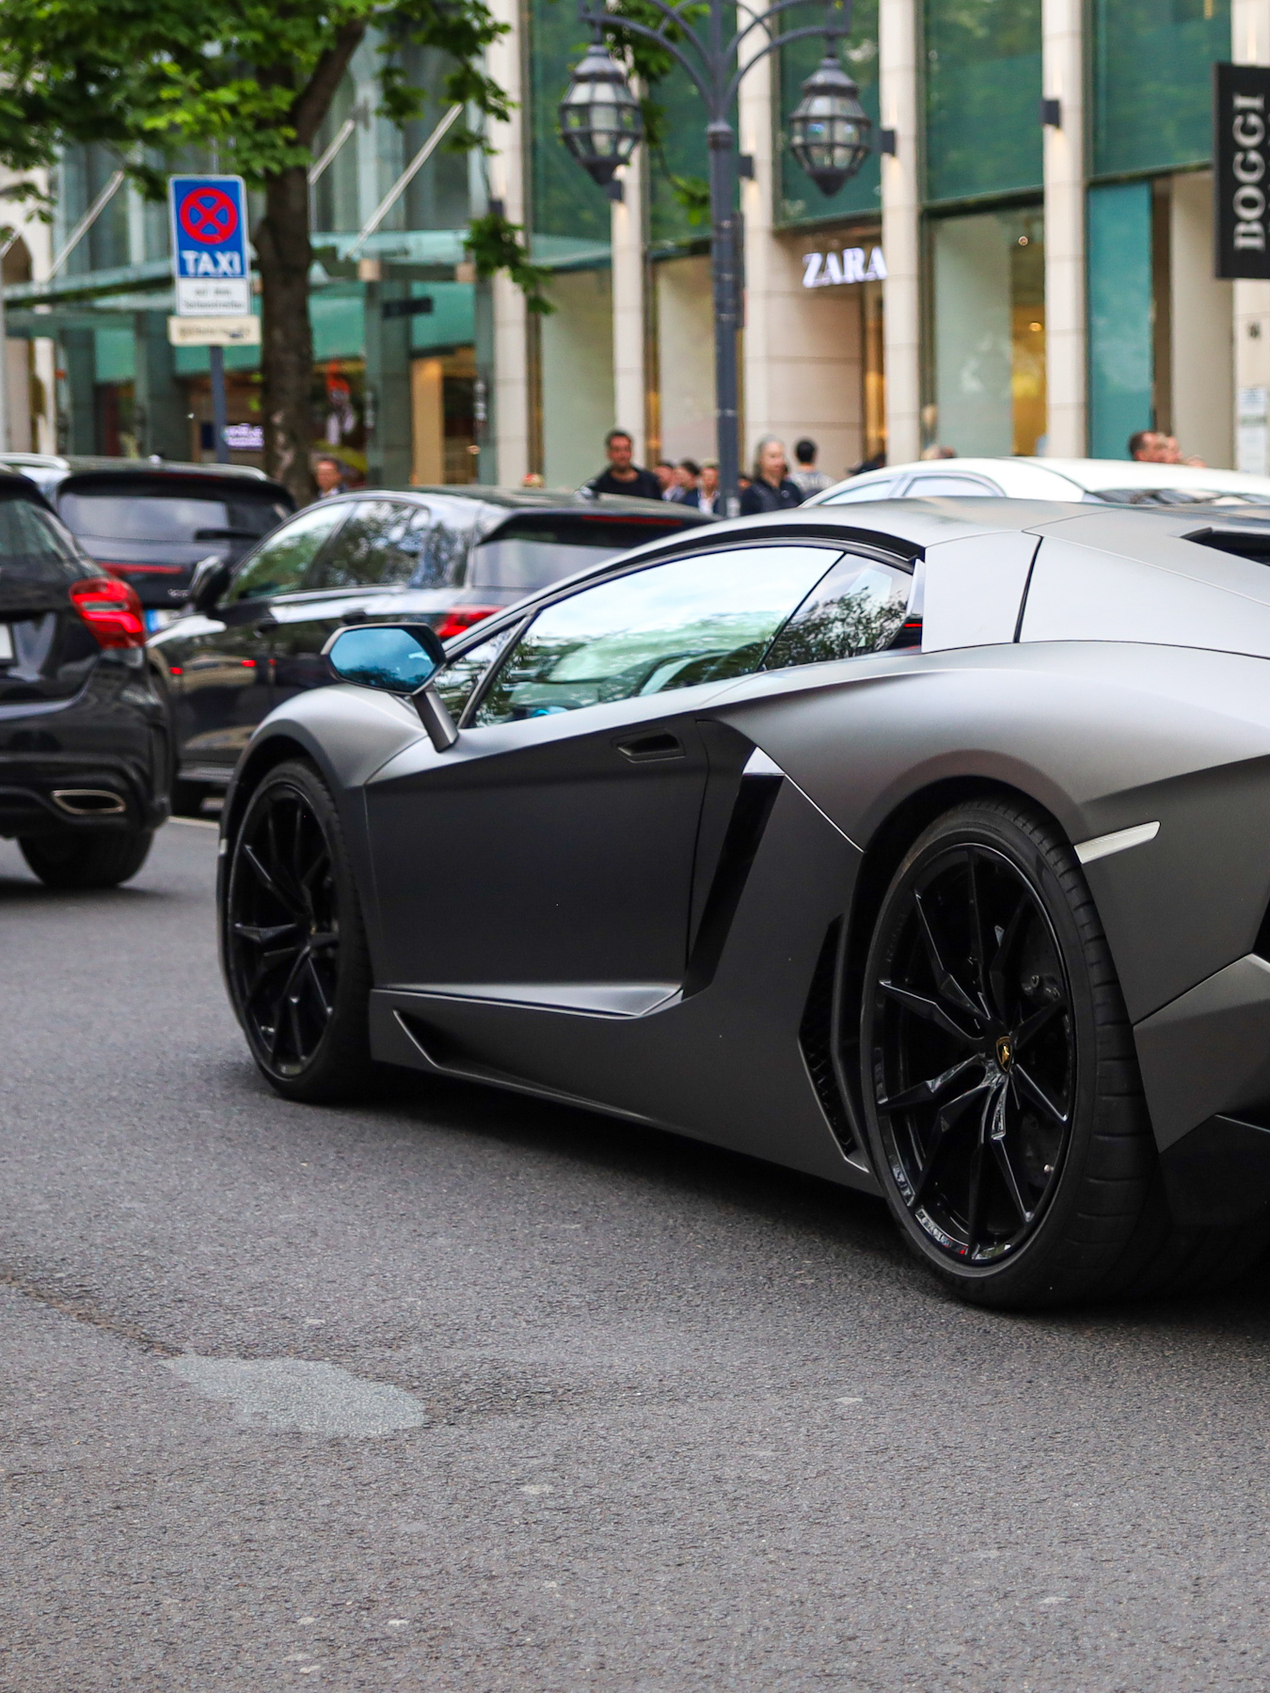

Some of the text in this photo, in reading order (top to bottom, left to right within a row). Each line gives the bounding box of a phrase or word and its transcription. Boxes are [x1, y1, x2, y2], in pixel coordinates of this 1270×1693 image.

[1232, 93, 1266, 250] BOGGI
[181, 251, 241, 275] TAXI
[802, 246, 888, 288] ZARA
